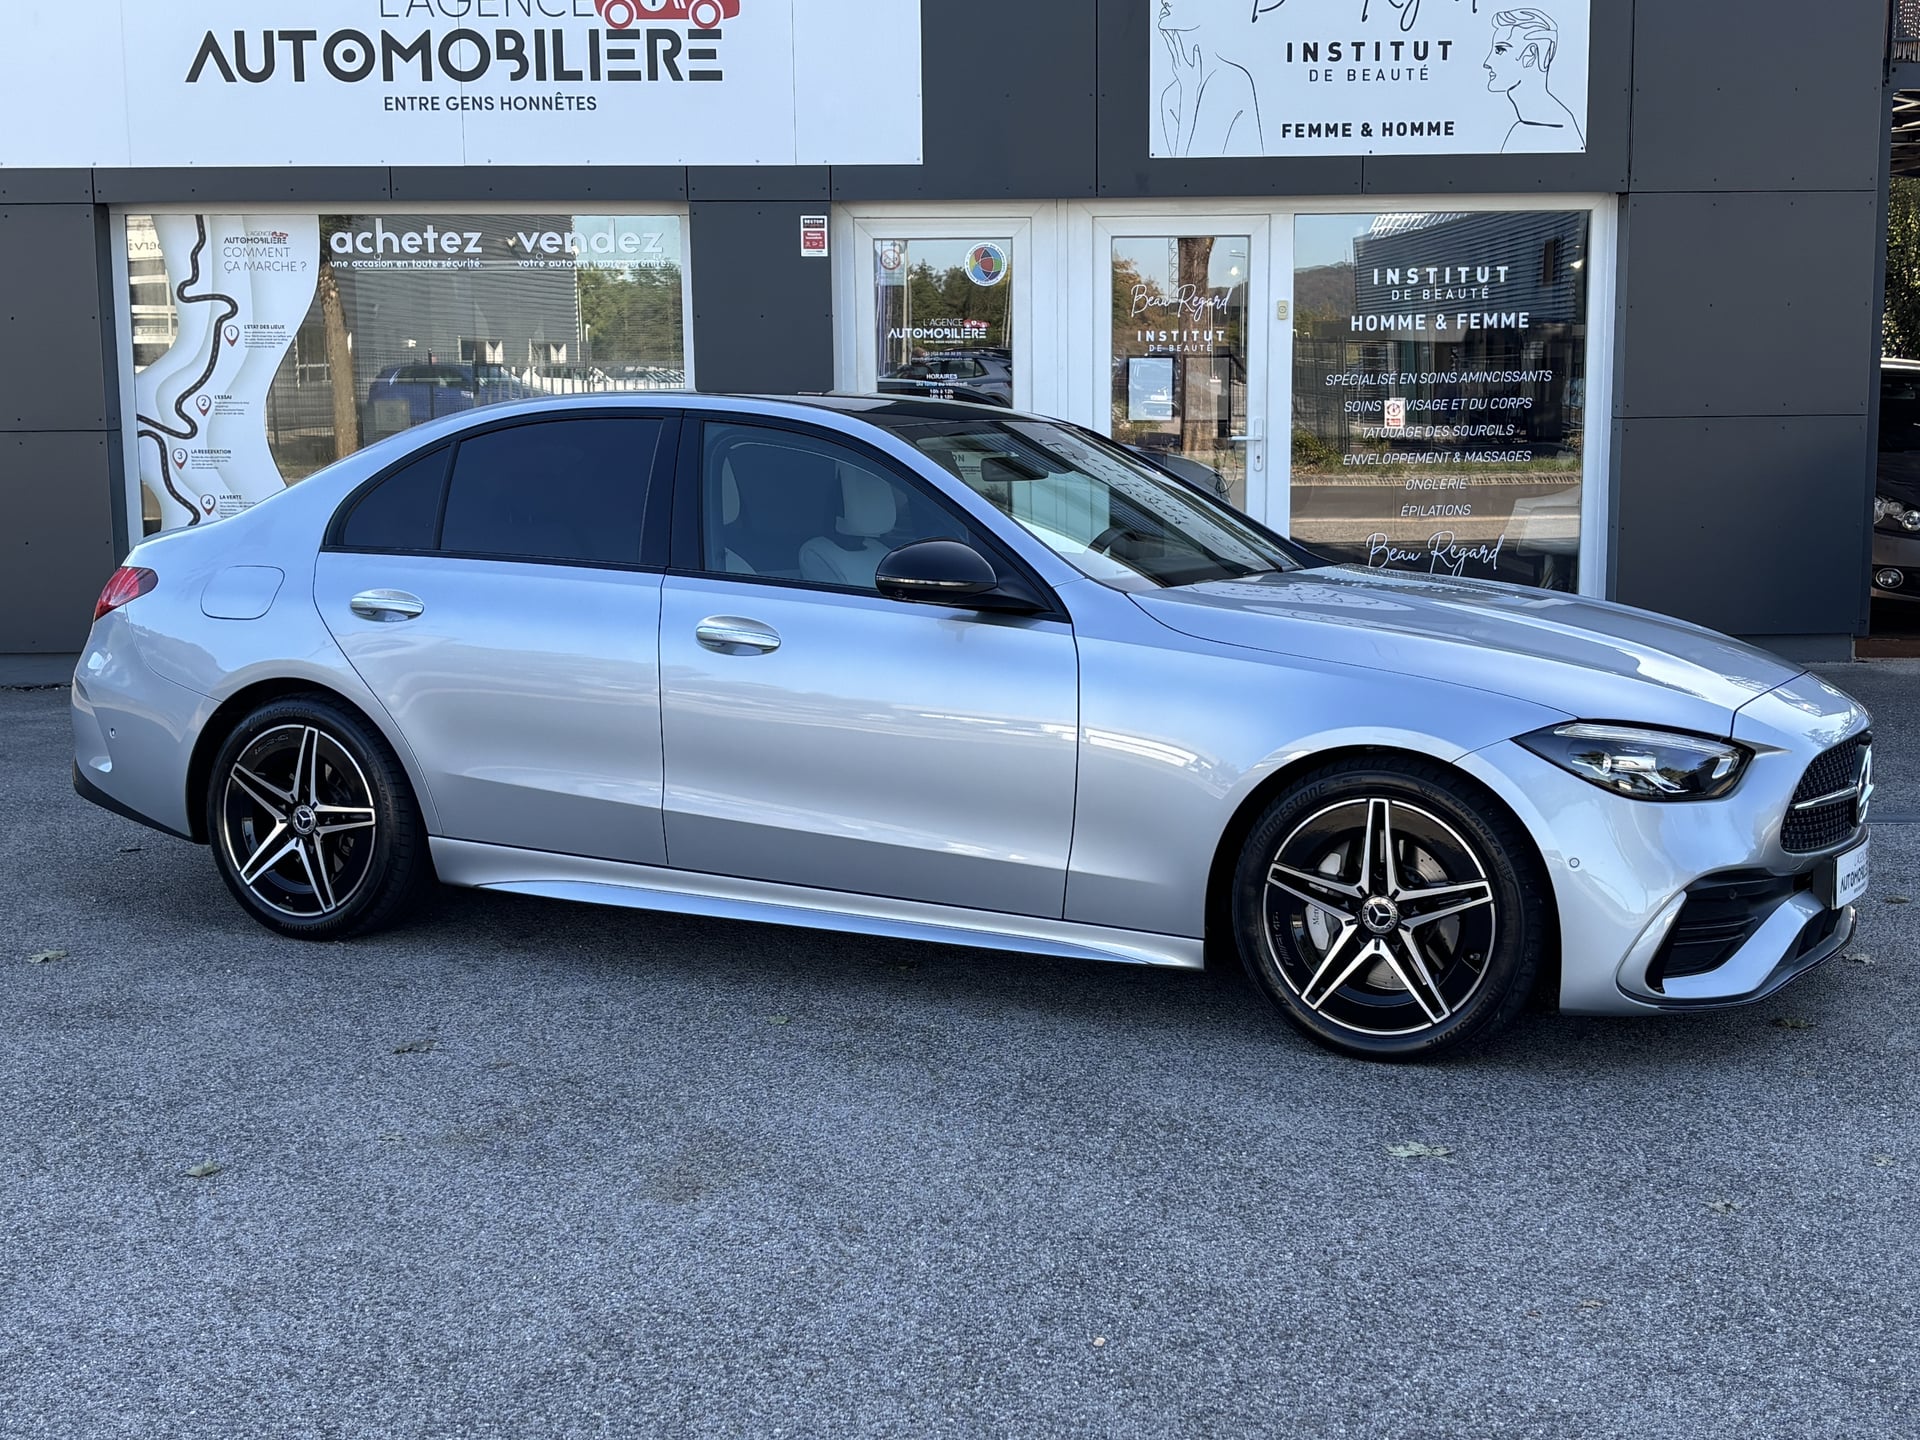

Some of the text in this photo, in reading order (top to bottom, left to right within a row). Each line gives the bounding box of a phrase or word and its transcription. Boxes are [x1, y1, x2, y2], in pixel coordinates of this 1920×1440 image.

[1286, 40, 1453, 63] INSTITUT
[1309, 64, 1429, 82] DE BEAUTÉ
[383, 92, 598, 111] ENTRE GENS HONNÊTES
[1281, 121, 1455, 138] FEMME & HOMME
[329, 217, 483, 254] achetez
[516, 217, 664, 254] vendez
[223, 246, 290, 258] COMMENT
[224, 260, 307, 274] ÇA MARCHE ?
[330, 260, 348, 268] une
[352, 258, 393, 268] occasion
[397, 260, 409, 268] en
[412, 258, 438, 268] toute
[516, 259, 545, 268] votre
[549, 259, 573, 268] auto
[1373, 266, 1509, 285] INSTITUT
[1391, 285, 1489, 300] DE BEAUTÉ
[1131, 283, 1232, 322] Beau Regard
[923, 318, 964, 327] L'AGENCE
[1351, 312, 1530, 332] HOMME & FEMME
[1137, 330, 1225, 342] INSTITUT
[1149, 344, 1162, 352] DE
[1325, 369, 1553, 386] SPÉCIALISÉ EN SOINS AMINCISSANTS
[201, 398, 207, 407] 2
[1344, 397, 1533, 413] SOINS VISAGE ET DU CORPS
[1362, 424, 1515, 439] TATOUAGE DES SOURCILS
[177, 450, 183, 460] 3
[1343, 450, 1532, 466] ENVELOPPEMENT & MASSAGES
[1405, 478, 1467, 491] ONGLERIE
[205, 498, 211, 506] 4
[1400, 503, 1472, 517] ÉPILATIONS
[1366, 530, 1505, 577] Beau Regard
